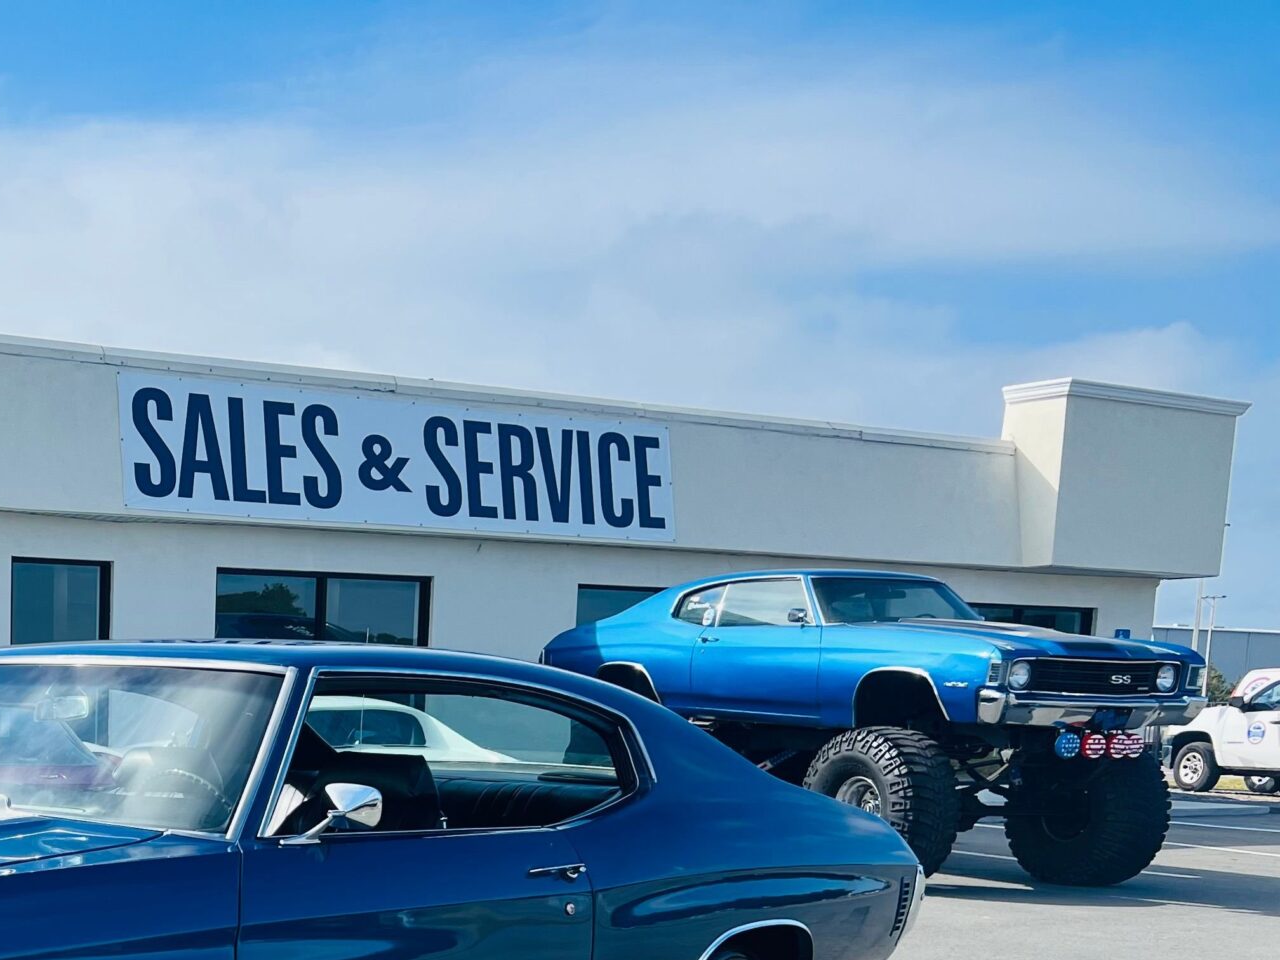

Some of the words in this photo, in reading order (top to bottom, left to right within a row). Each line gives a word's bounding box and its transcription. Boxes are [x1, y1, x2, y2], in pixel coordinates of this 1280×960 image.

[131, 387, 342, 509] SALES
[358, 434, 413, 493] &
[423, 416, 666, 529] SERVICE
[1110, 674, 1132, 685] SS
